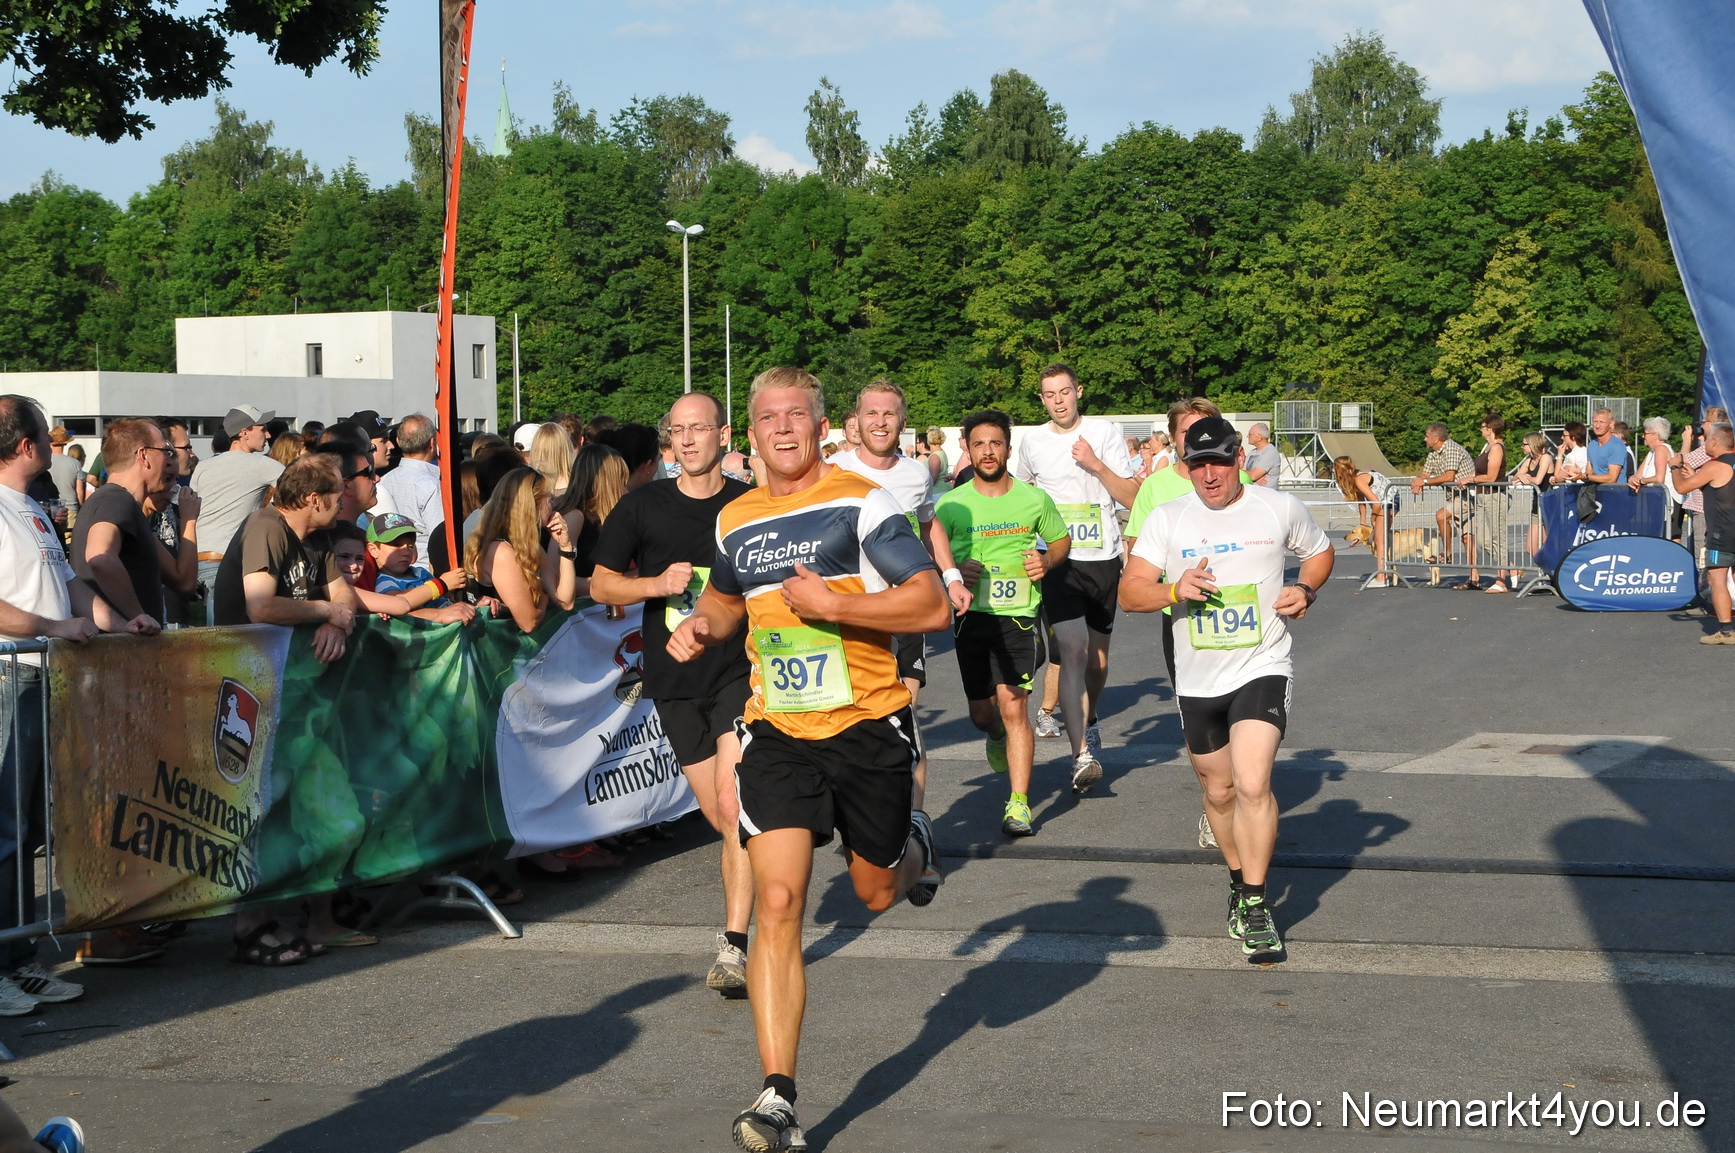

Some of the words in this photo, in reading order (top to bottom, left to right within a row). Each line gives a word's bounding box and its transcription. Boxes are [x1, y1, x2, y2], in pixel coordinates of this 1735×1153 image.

[966, 521, 1020, 534] autoladen
[981, 525, 1030, 538] neumarkt
[1244, 537, 1275, 546] energie
[746, 540, 822, 567] Fischer
[1593, 568, 1684, 587] Fischer
[991, 580, 1017, 599] 38
[1602, 585, 1678, 596] AUTOMOBILE
[1190, 605, 1258, 634] 1194
[770, 653, 828, 691] 397
[798, 690, 824, 698] Schindler
[222, 755, 240, 775] 1628
